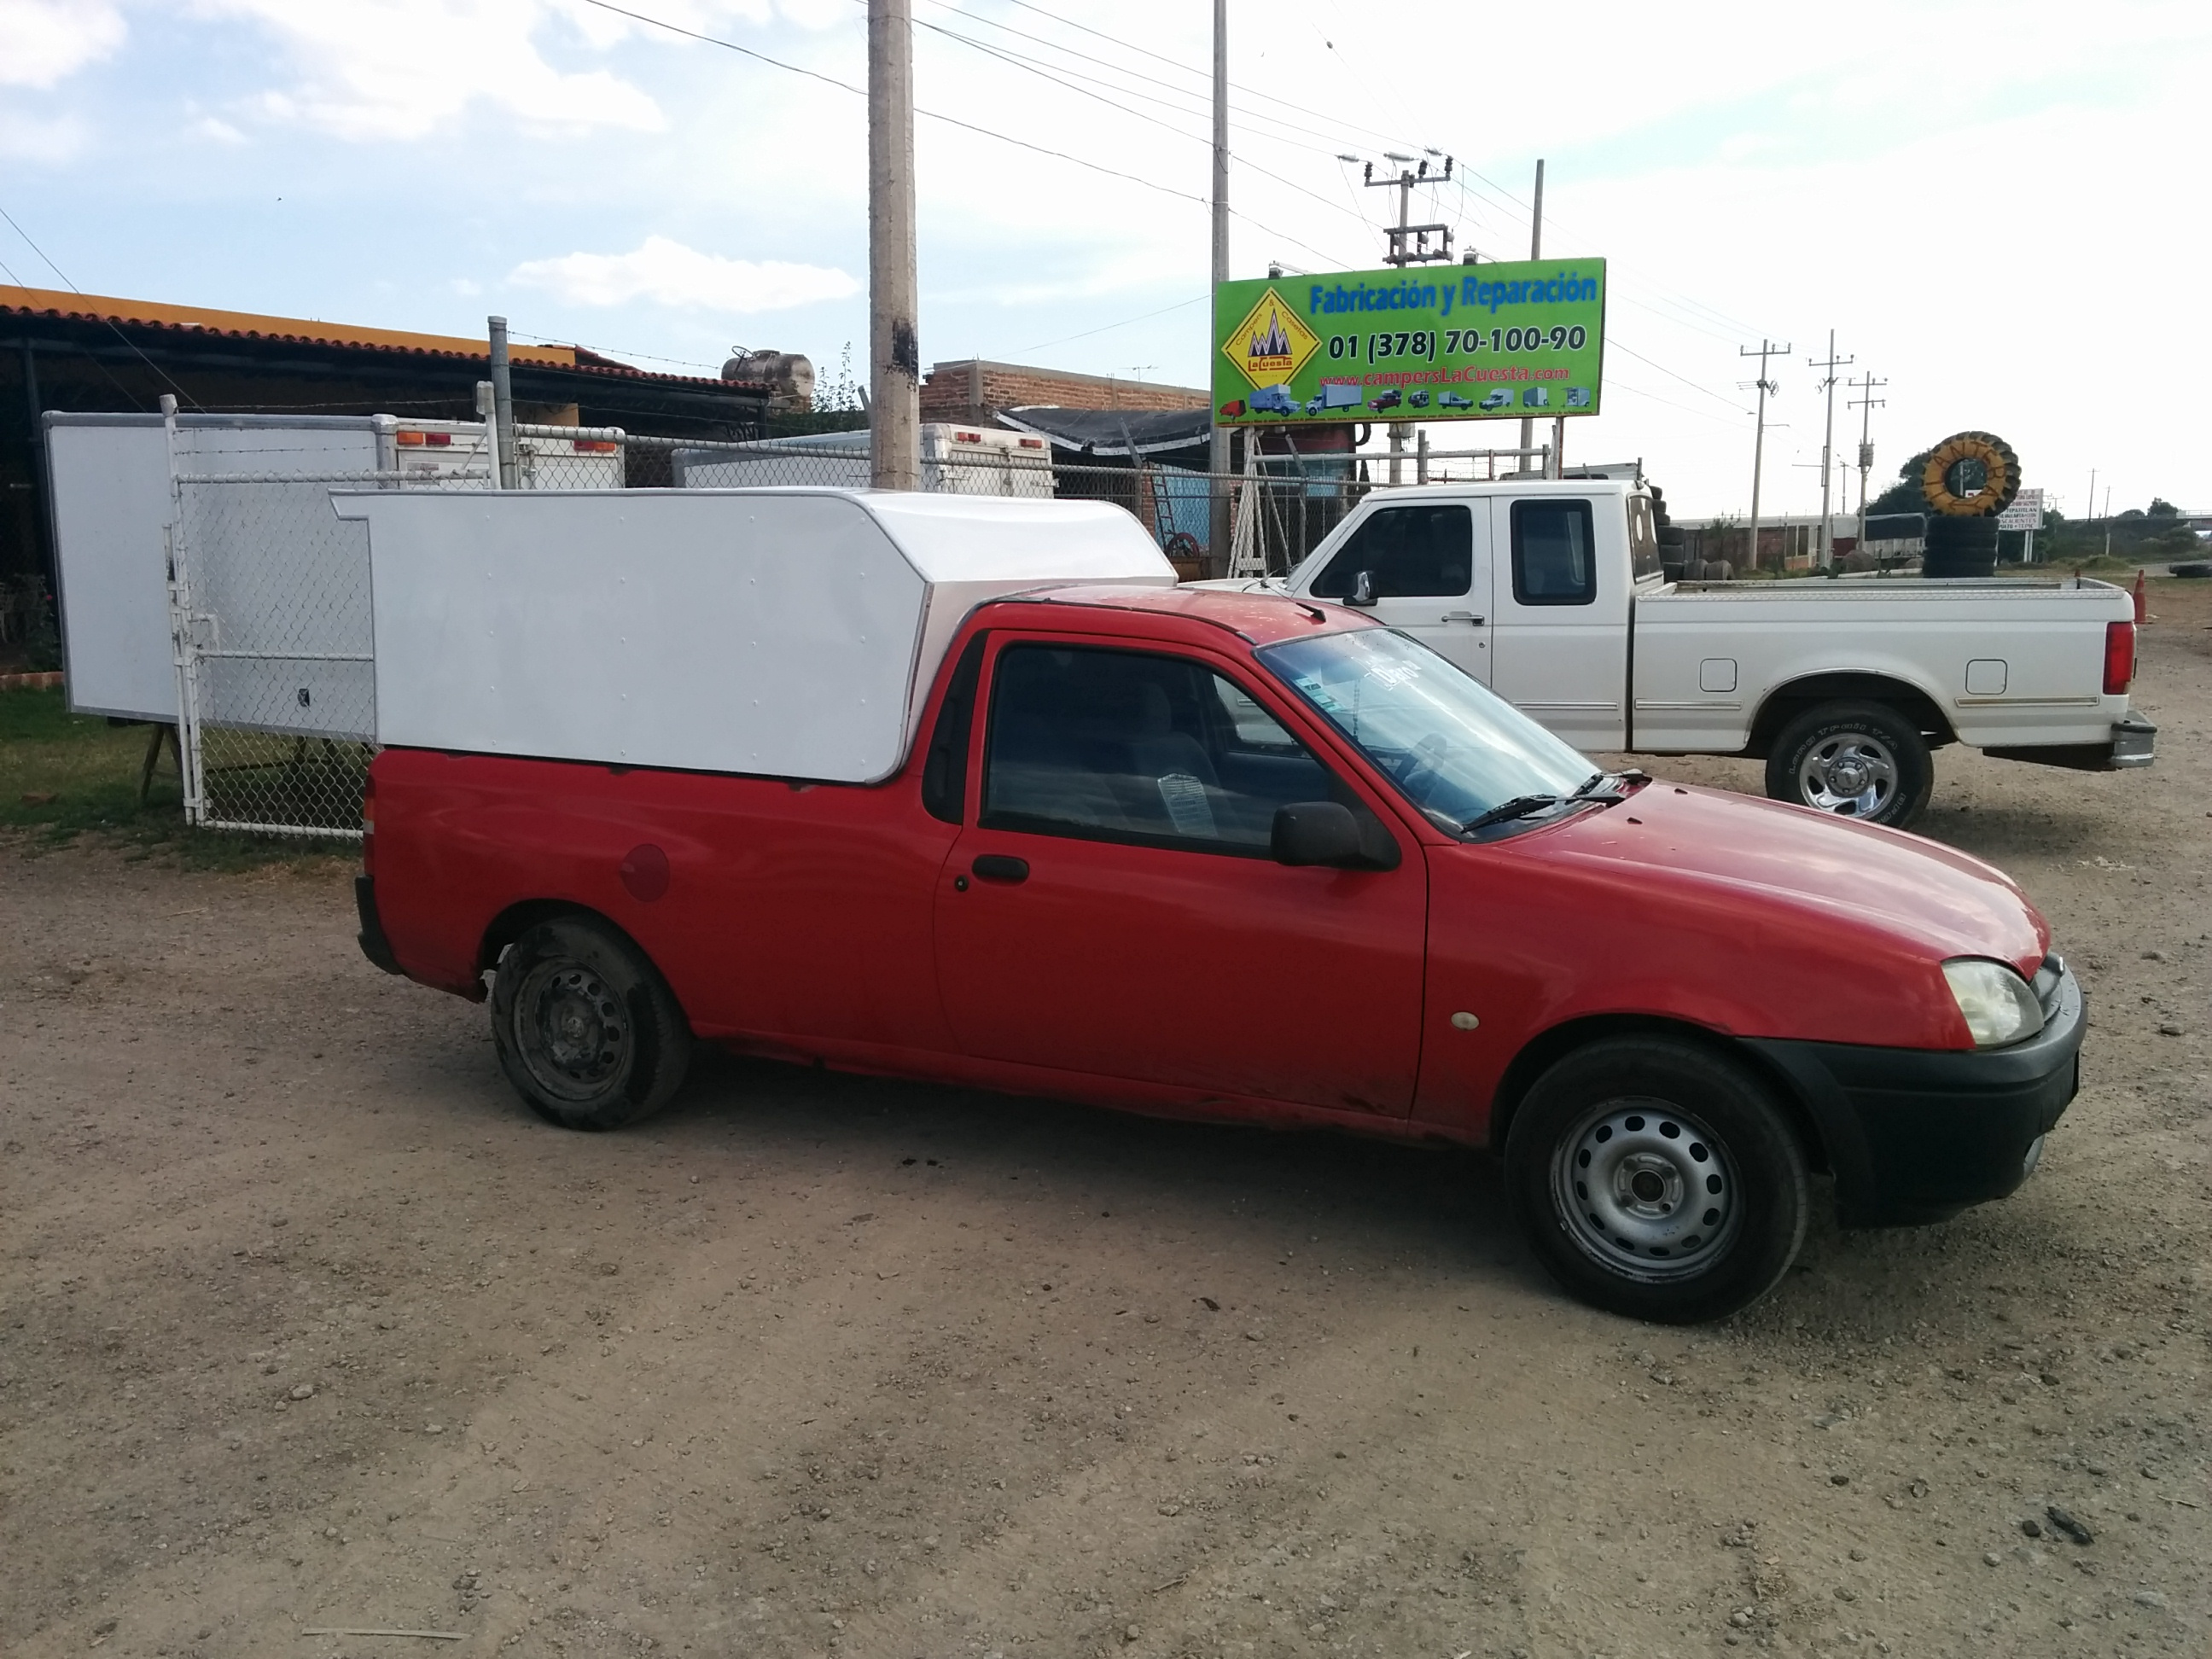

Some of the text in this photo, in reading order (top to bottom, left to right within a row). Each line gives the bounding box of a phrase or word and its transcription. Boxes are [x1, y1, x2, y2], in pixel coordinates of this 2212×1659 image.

[1310, 271, 1597, 317] Fabricación y Reparación
[1236, 312, 1263, 346] Campers
[1281, 311, 1308, 340] Casetas
[1329, 324, 1586, 365] 01 (378) 70-100-90
[1319, 365, 1569, 389] www.campersLaCuesta.com
